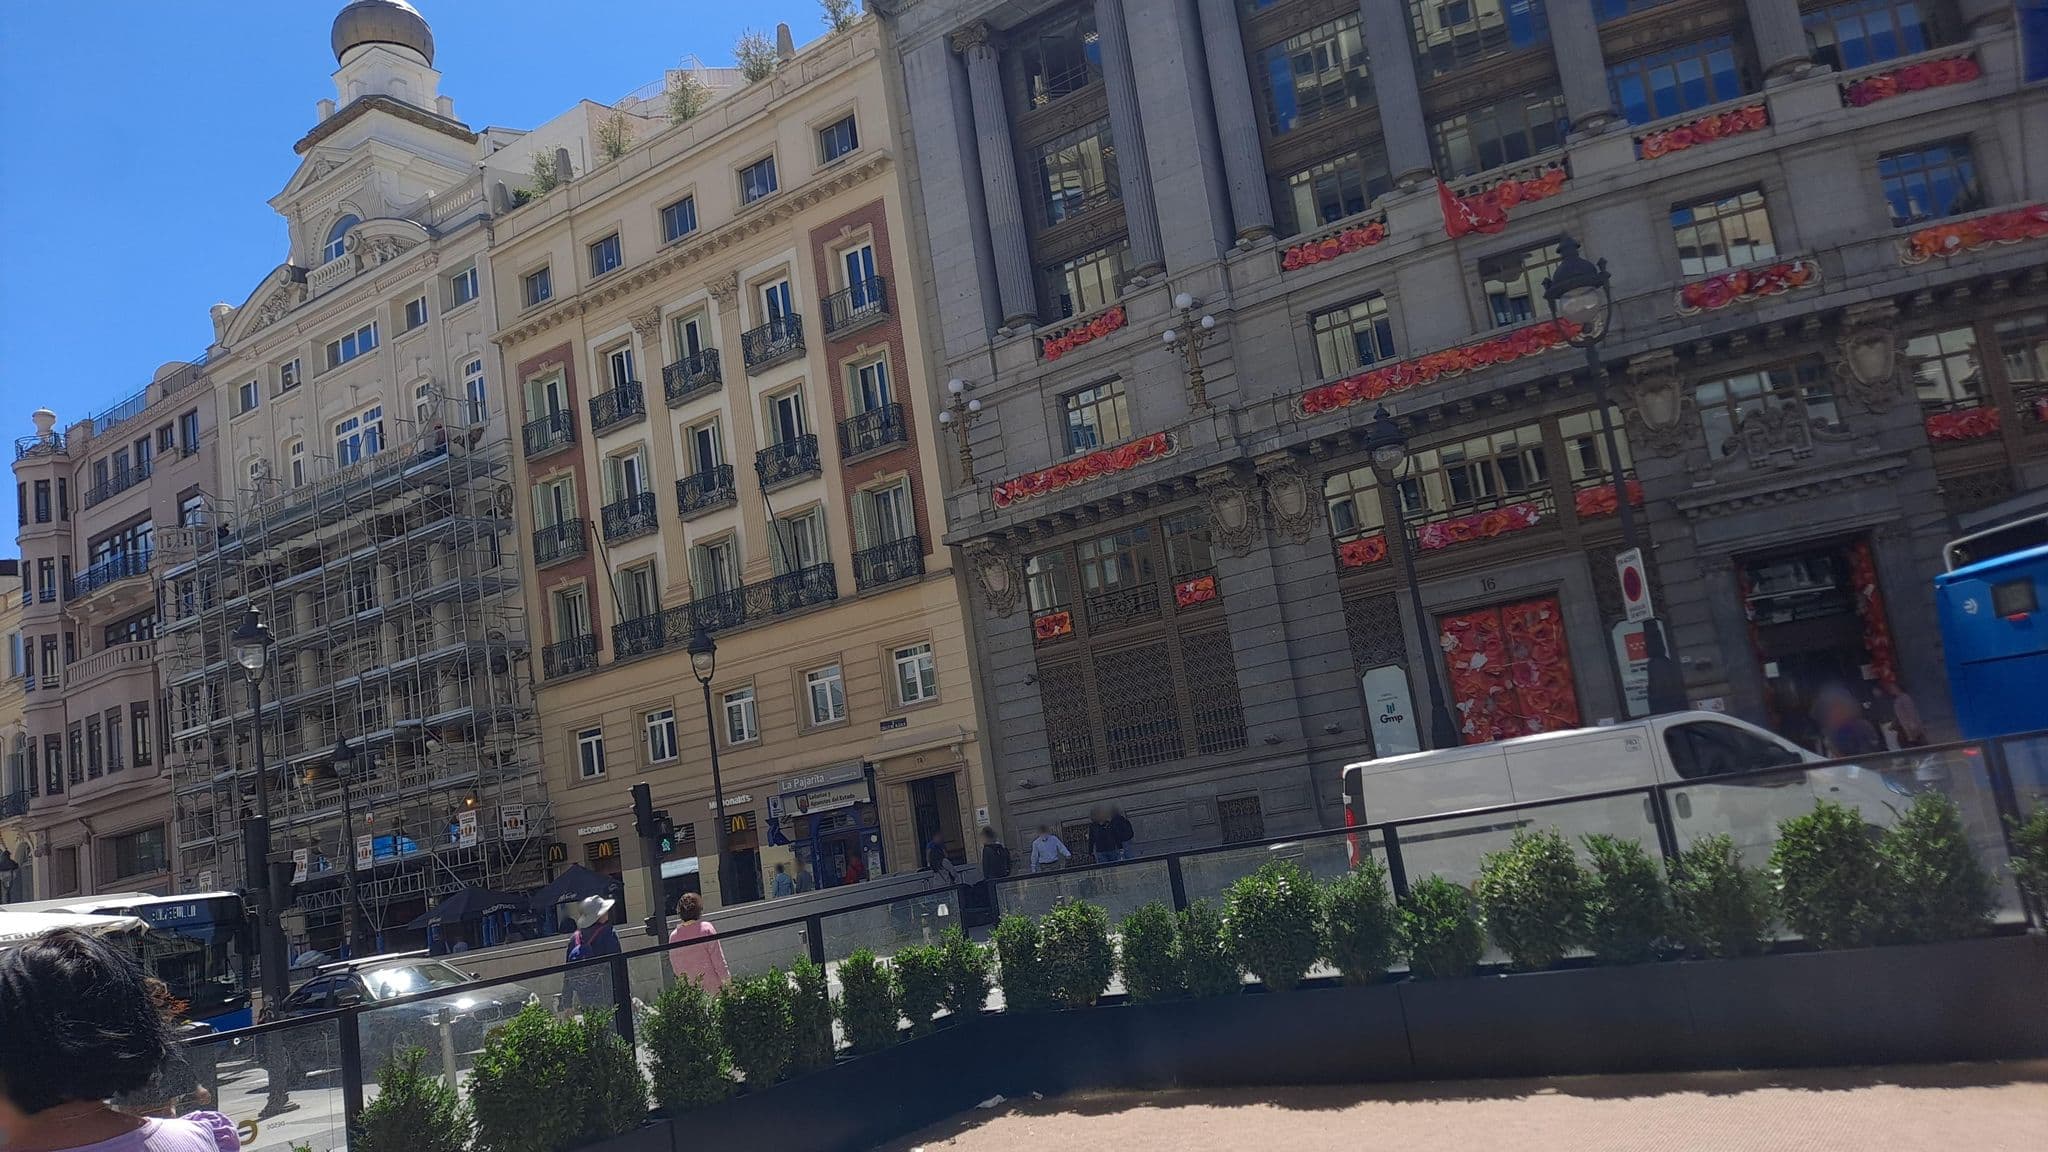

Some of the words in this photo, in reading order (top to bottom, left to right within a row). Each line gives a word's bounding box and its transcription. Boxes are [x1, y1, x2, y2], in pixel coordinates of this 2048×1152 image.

[1481, 578, 1496, 591] 16
[1380, 714, 1403, 724] Gmp
[782, 781, 792, 790] La
[793, 774, 825, 789] Pajarita
[709, 795, 752, 809] Monald's
